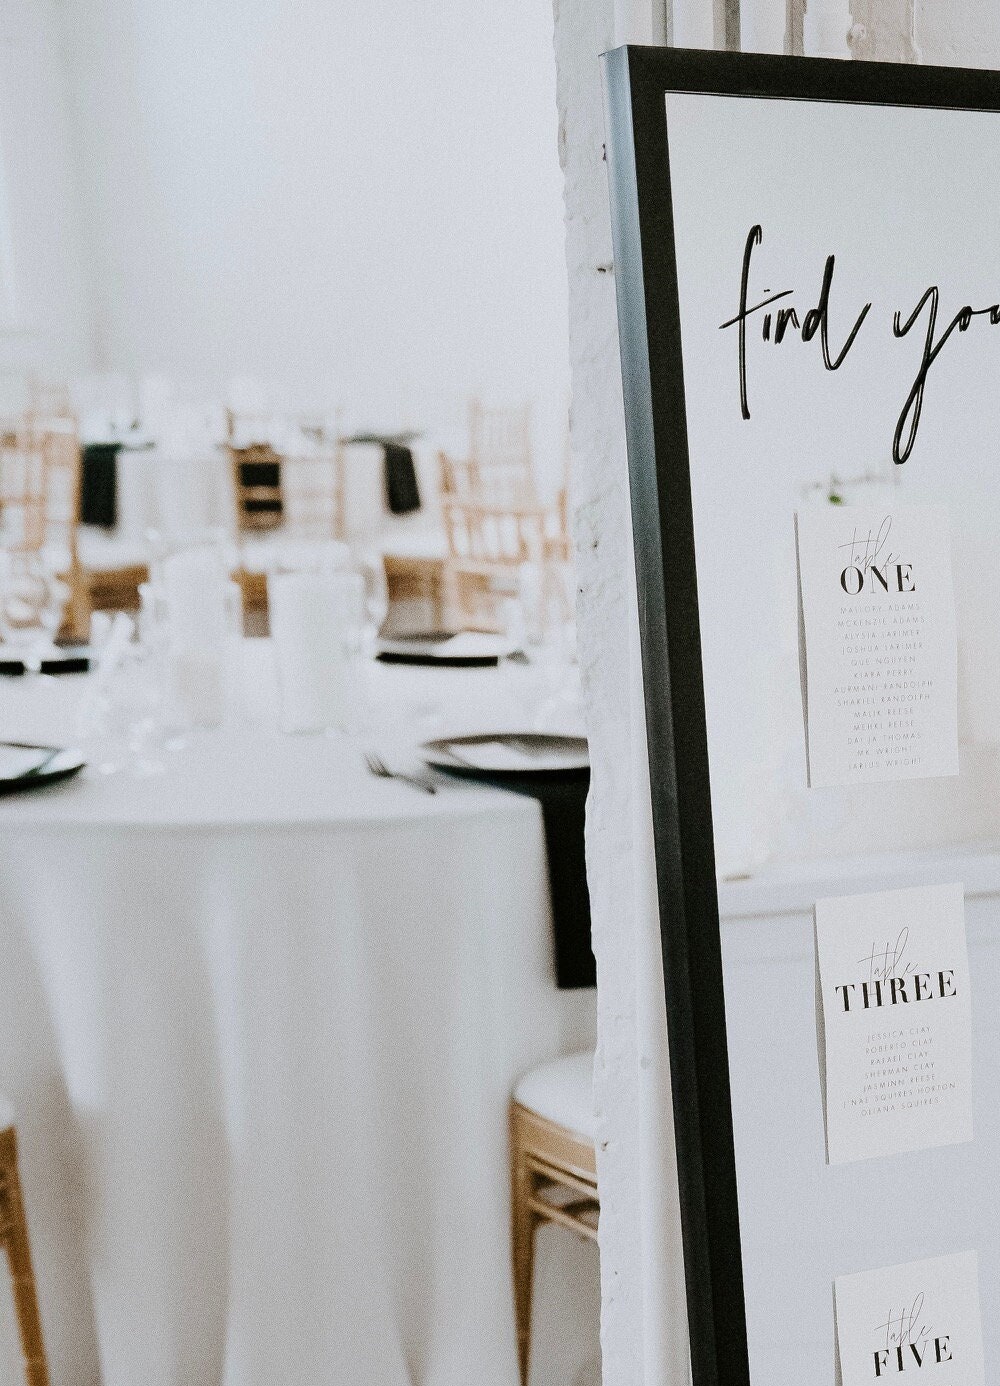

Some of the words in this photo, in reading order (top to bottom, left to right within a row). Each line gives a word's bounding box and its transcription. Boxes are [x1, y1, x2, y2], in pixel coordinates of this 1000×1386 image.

[719, 223, 872, 421] find
[840, 564, 916, 596] ONE
[888, 602, 921, 611] ADAMS
[893, 615, 925, 625] ADAMS
[842, 645, 879, 654] JOSHUA
[876, 655, 916, 665] NGUYEN
[884, 680, 933, 690] RANDOLPH
[881, 693, 930, 704] RANDOLPH
[883, 732, 922, 742] THOMAS
[835, 970, 957, 1012] THREE
[867, 1029, 904, 1043] JESSICA
[909, 1025, 931, 1036] CLAY
[865, 1041, 907, 1055] ROBERTO
[912, 1037, 933, 1047] CLAY
[907, 1050, 929, 1060] CLAY
[864, 1066, 908, 1080] SHERMAN
[914, 1061, 935, 1071] CLAY
[871, 1335, 953, 1378] FIVE
